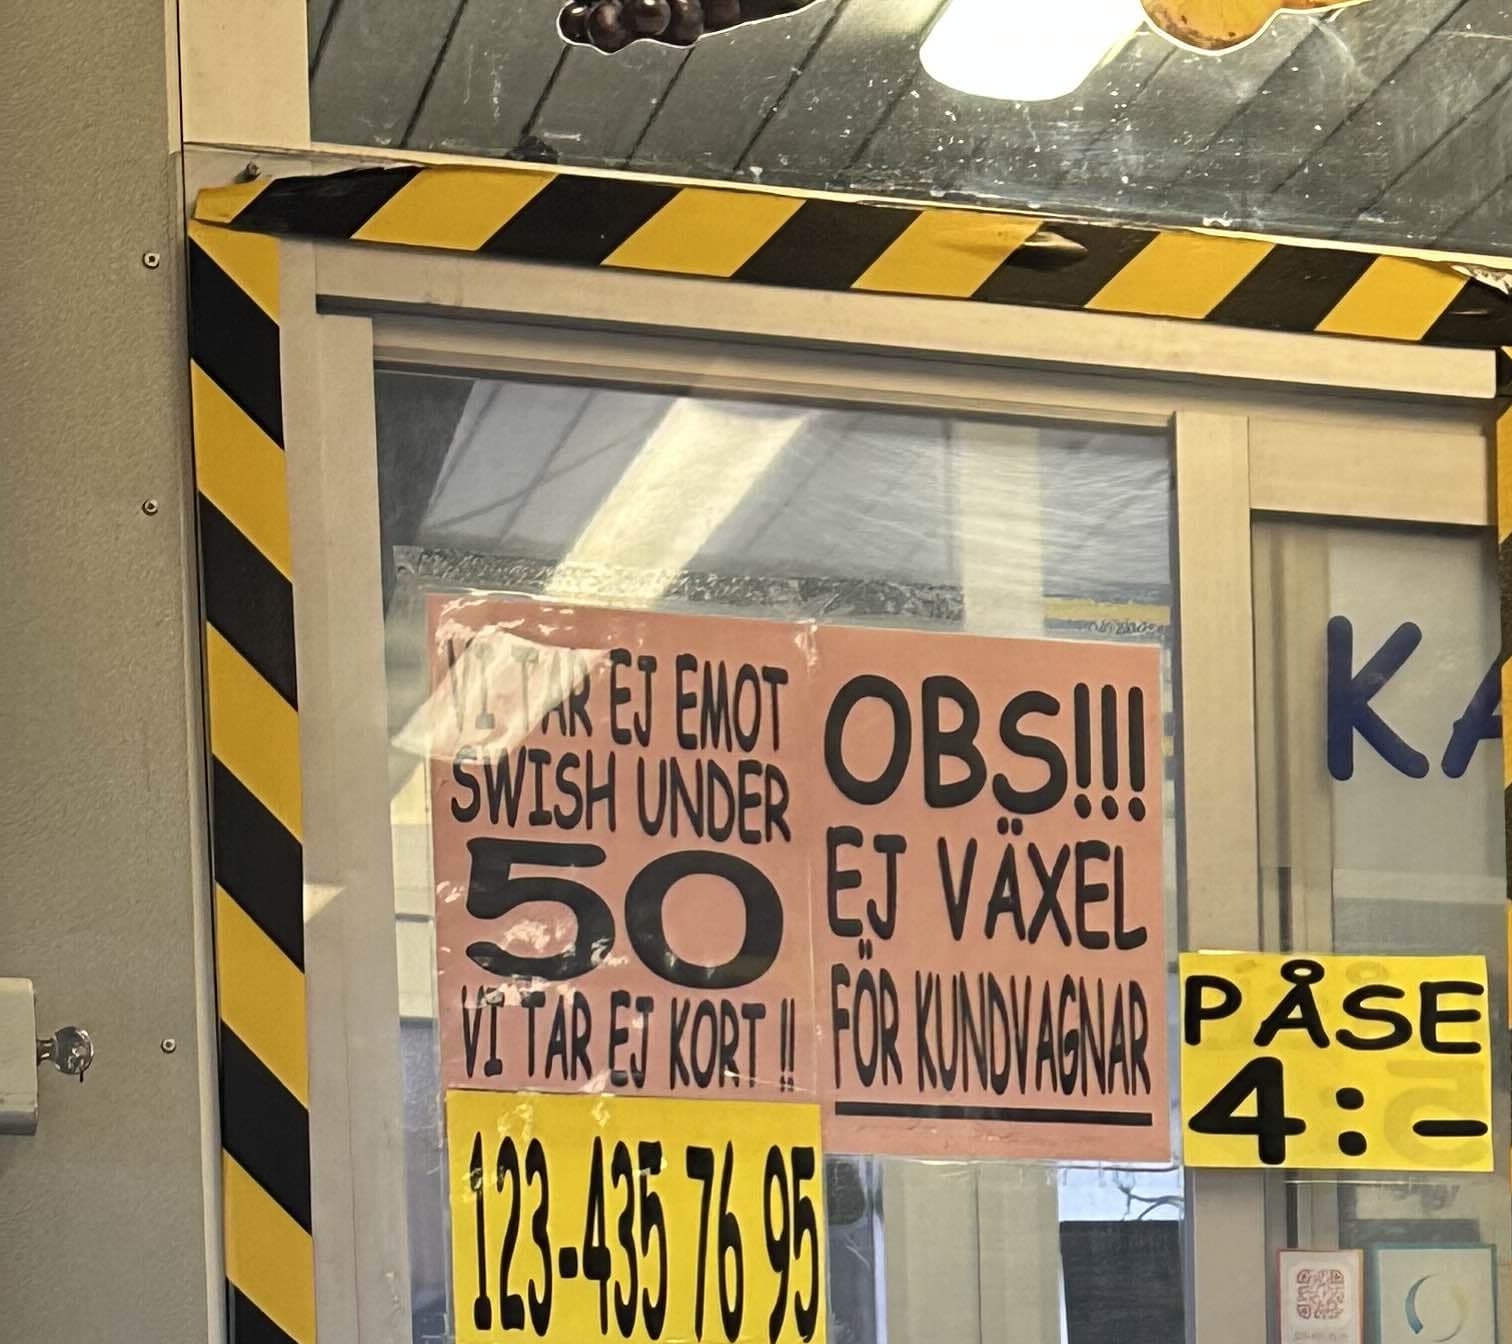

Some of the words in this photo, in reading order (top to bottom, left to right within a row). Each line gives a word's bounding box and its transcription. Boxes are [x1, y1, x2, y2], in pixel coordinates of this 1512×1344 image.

[609, 648, 657, 748] EJ
[676, 653, 789, 754] EMOT
[823, 673, 1146, 822] OBS!!!
[450, 746, 617, 832] SWISH
[637, 757, 791, 842] UNDER
[465, 838, 783, 989] 50
[825, 825, 906, 941] EJ
[938, 817, 1147, 950] VÄXEL
[461, 983, 504, 1078] VI
[526, 988, 593, 1083] TAR
[607, 990, 654, 1088] EJ
[669, 993, 764, 1090] KORT
[834, 940, 903, 1090] FÖR
[916, 970, 1151, 1096] KUNDVAGNAR
[1182, 959, 1485, 1055] PÅSE
[1187, 1056, 1489, 1165] 4:-
[471, 1131, 668, 1340] 123-435
[686, 1141, 743, 1343] 76
